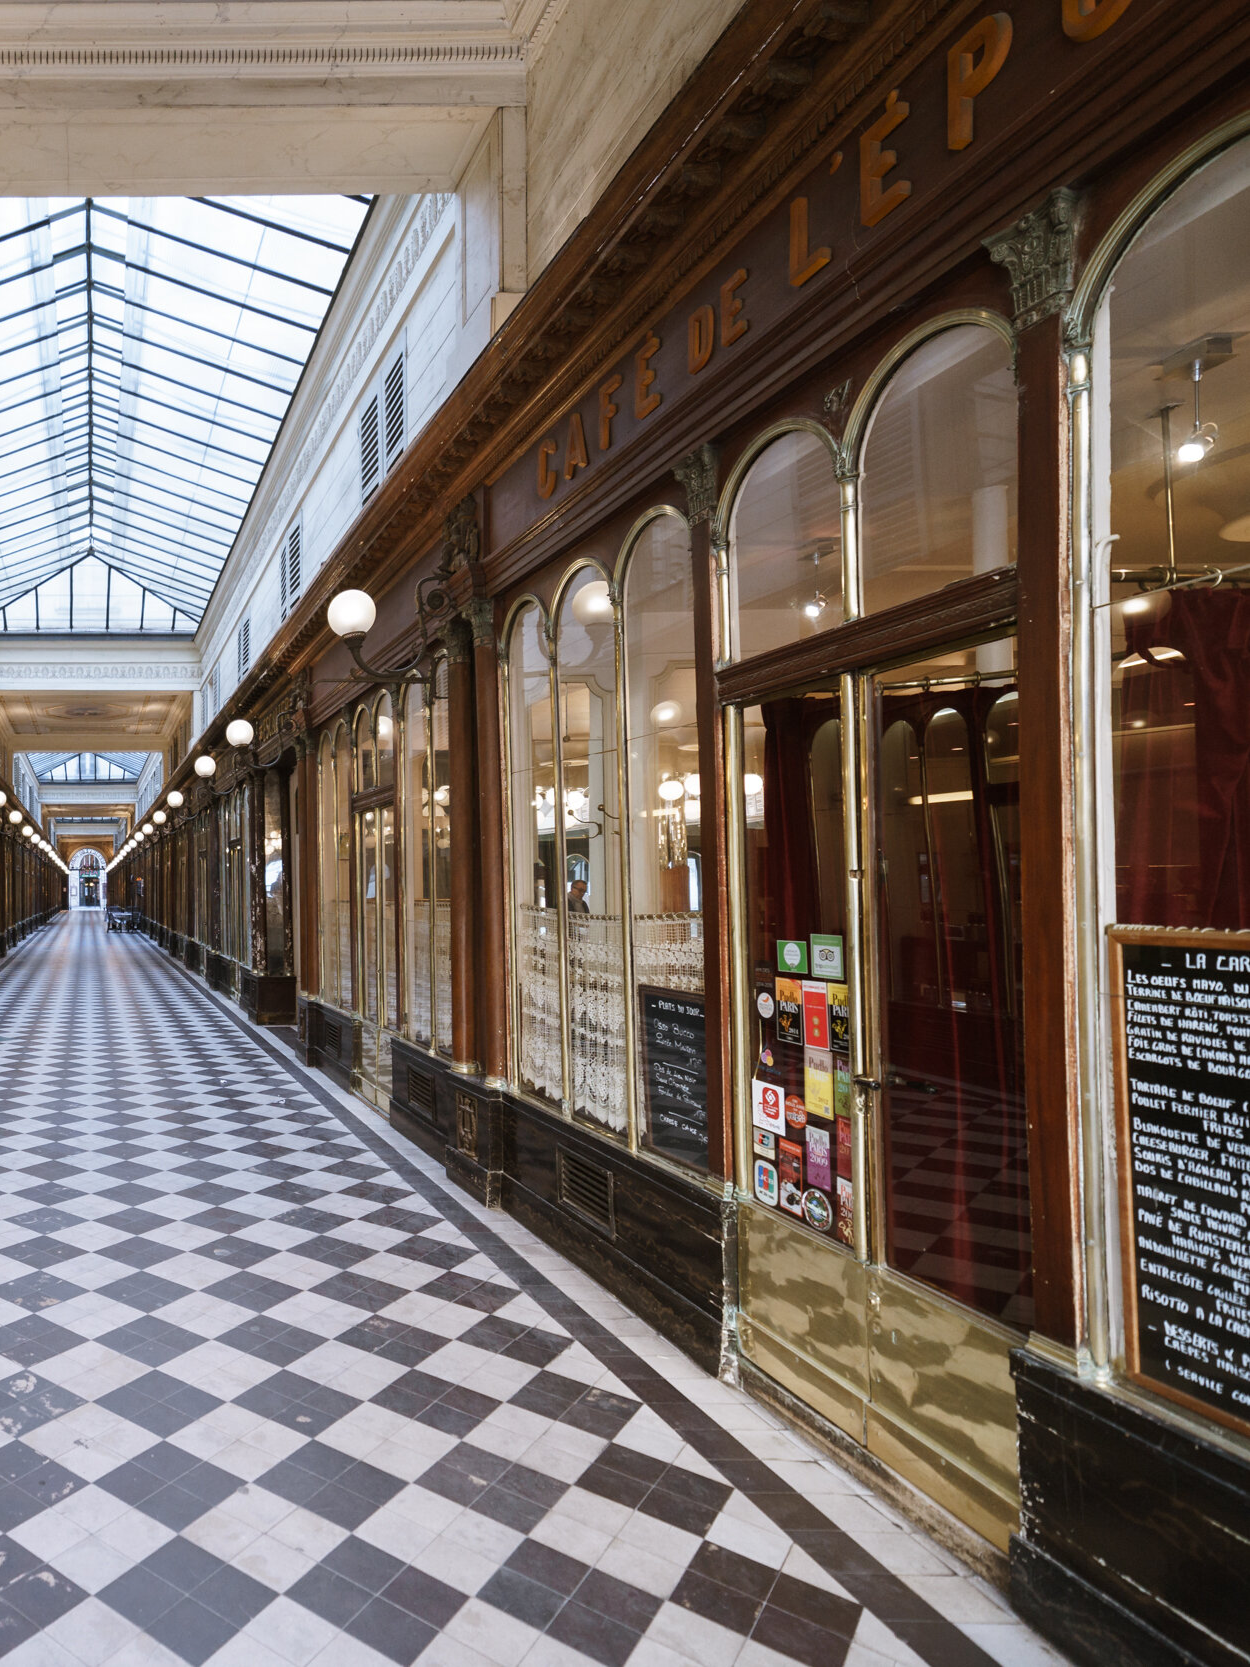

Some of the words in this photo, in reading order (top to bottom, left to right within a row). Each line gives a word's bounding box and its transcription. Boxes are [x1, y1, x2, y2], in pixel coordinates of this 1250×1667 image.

[535, 329, 663, 499] CAFÉ
[687, 268, 751, 375] DE
[1185, 953, 1206, 969] LA
[1127, 969, 1149, 984] LES
[1125, 984, 1167, 999] TERRINE
[1171, 990, 1183, 1001] DE
[658, 1000, 675, 1011] PLATS
[780, 1000, 799, 1013] PARIS
[1126, 999, 1182, 1016] CAMEMBERT
[1160, 1016, 1174, 1027] DE
[1126, 1023, 1162, 1039] GRATIN
[1166, 1030, 1178, 1041] DE
[1233, 1040, 1246, 1051] DE
[1127, 1035, 1150, 1049] FOIE
[1152, 1041, 1177, 1054] GRAS
[1181, 1045, 1194, 1057] DE
[1196, 1046, 1236, 1063] CANARD
[1128, 1047, 1182, 1067] ESCARGOTS
[1187, 1059, 1201, 1071] DE
[1129, 1078, 1177, 1098] TARTARE
[1182, 1090, 1195, 1102] DE
[1131, 1092, 1167, 1110] POULET
[1171, 1101, 1217, 1121] FERMIER
[1133, 1116, 1199, 1144] BLANQUETTE
[1206, 1136, 1221, 1149] DE
[1202, 1120, 1244, 1139] FRITES
[810, 1153, 828, 1167] 2009
[1134, 1146, 1172, 1166] SOURIS
[1134, 1160, 1156, 1176] DOS
[1160, 1168, 1173, 1181] DE
[1177, 1172, 1238, 1199] CABILLAUD
[1183, 1199, 1197, 1212] DE
[1201, 1203, 1247, 1228] CANARD
[1168, 1219, 1182, 1234] DE
[1141, 1283, 1189, 1314] RISOTTO
[1208, 1312, 1223, 1328] LA
